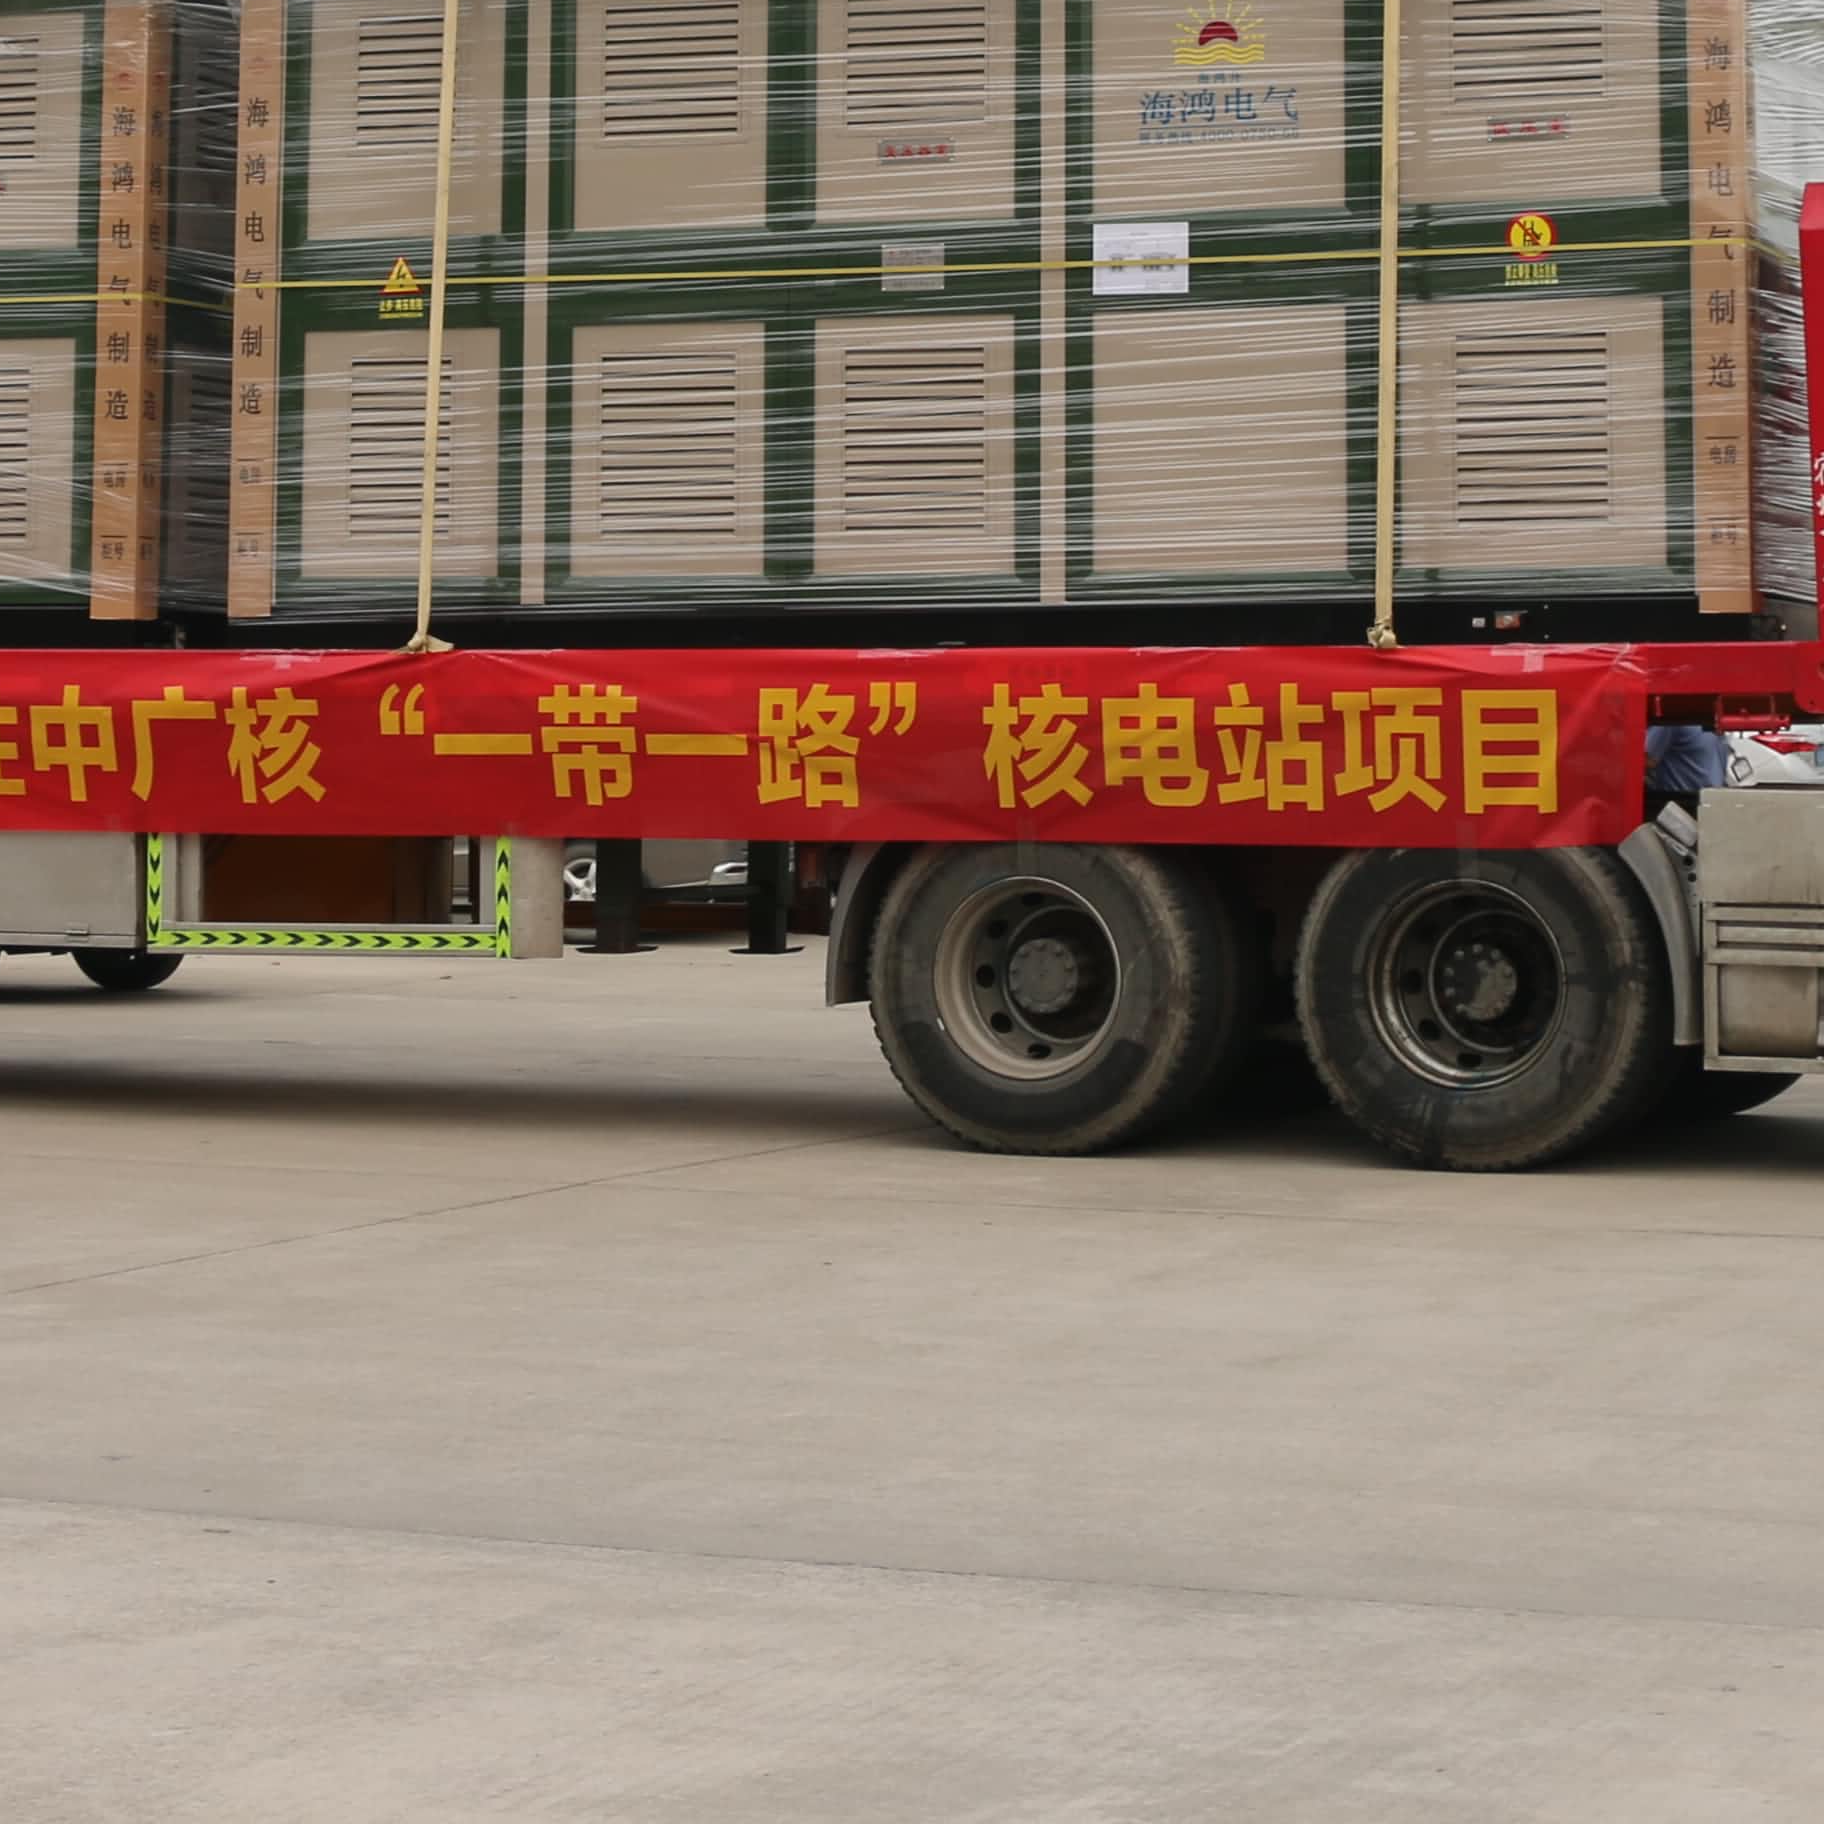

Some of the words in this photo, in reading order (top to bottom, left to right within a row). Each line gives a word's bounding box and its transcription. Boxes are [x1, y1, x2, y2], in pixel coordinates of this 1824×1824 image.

[104, 105, 137, 423] 海鸿电气制造
[239, 95, 271, 416] 海鸿电气制造
[1140, 85, 1298, 126] 海鸿电气
[1702, 36, 1738, 391] 海鸿电气制造
